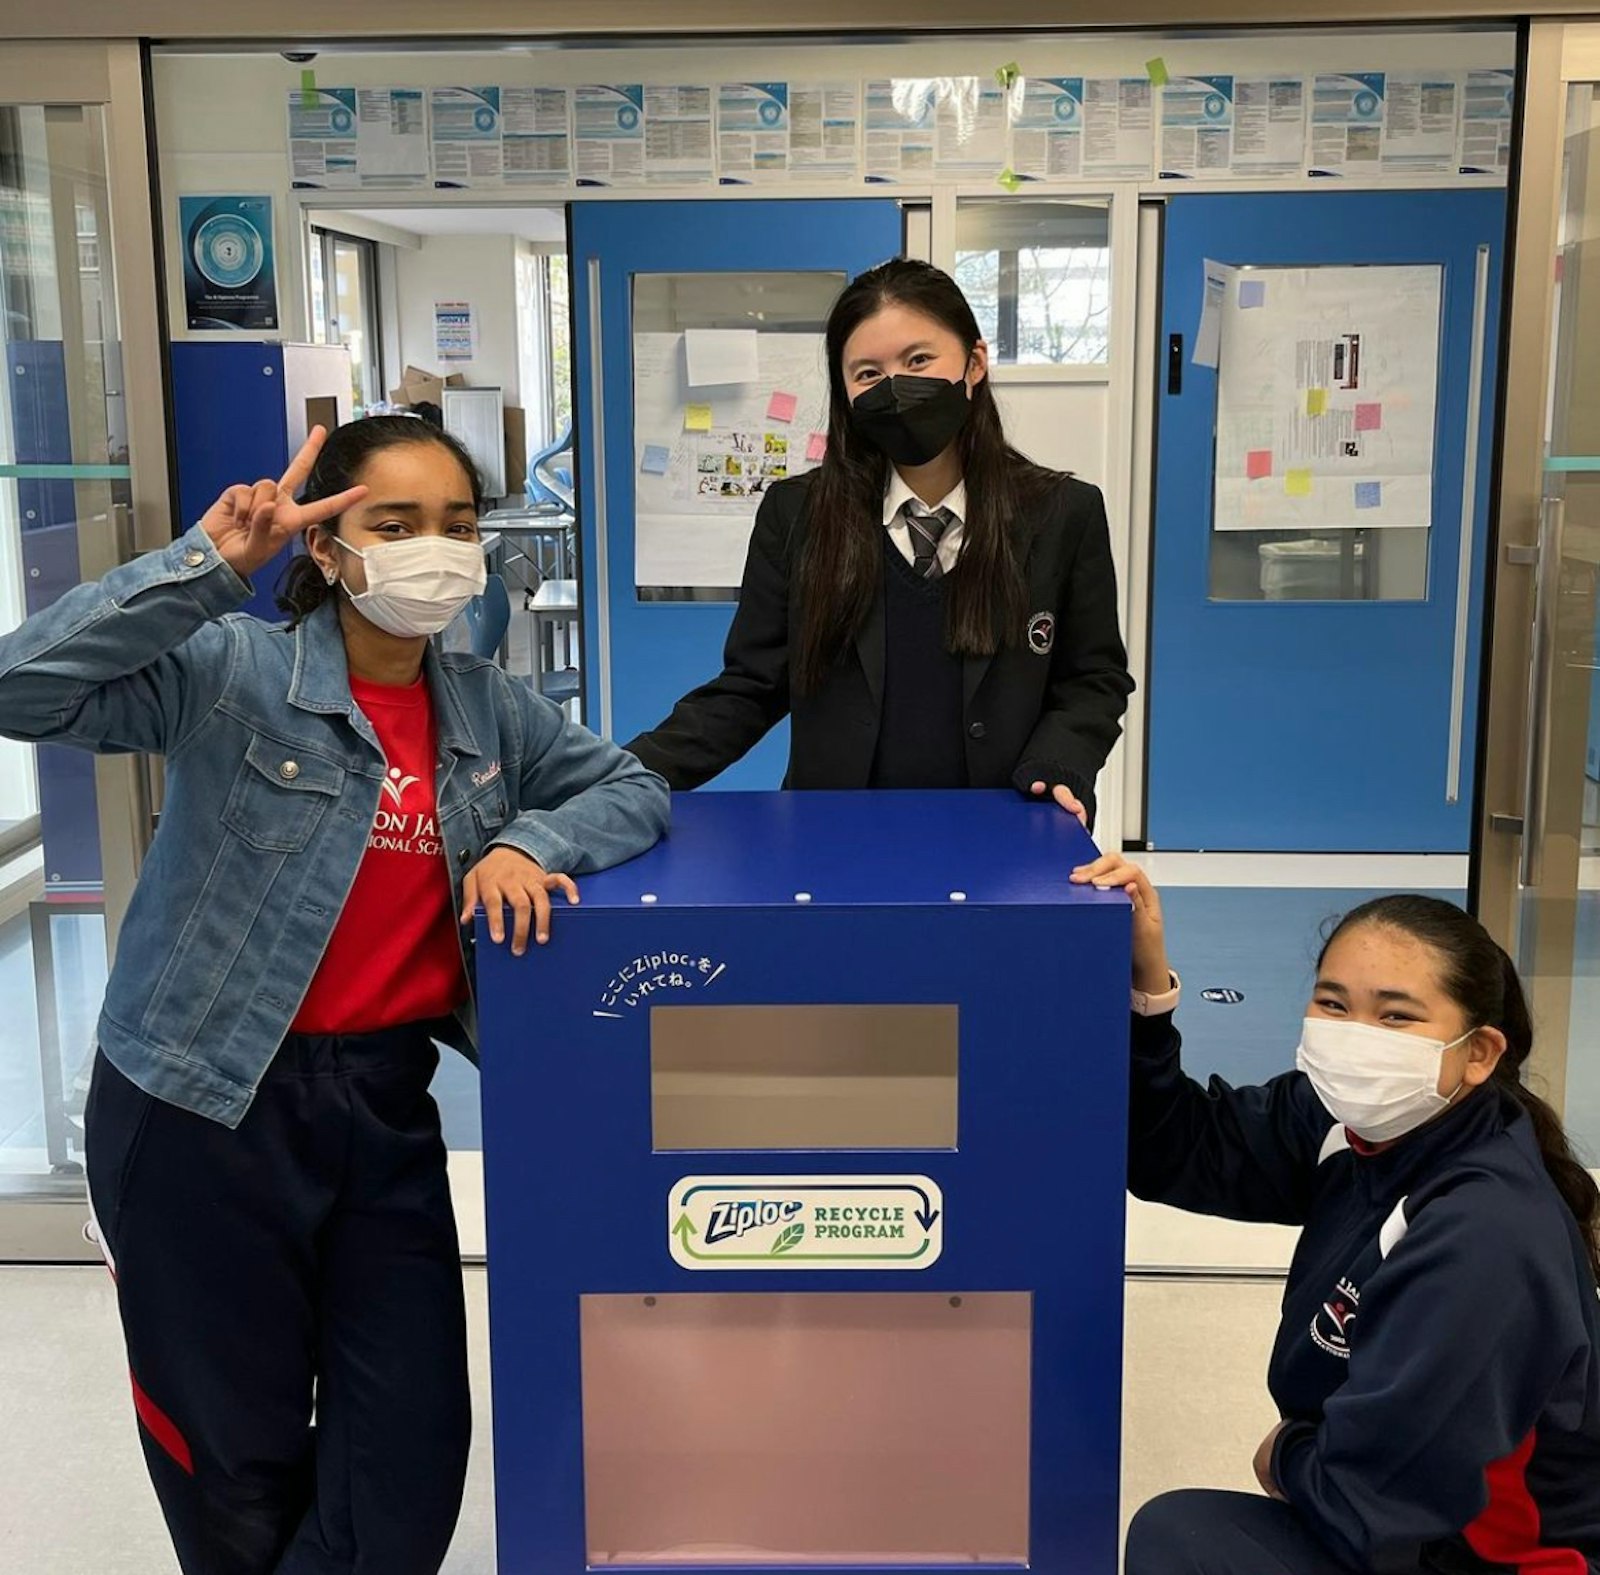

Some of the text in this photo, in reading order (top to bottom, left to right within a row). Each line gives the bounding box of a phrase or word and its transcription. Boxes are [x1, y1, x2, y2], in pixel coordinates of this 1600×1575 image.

[410, 813, 442, 840] JA
[705, 1200, 905, 1244] Ziploc RECYCLE
[814, 1224, 905, 1239] PROGRAM
